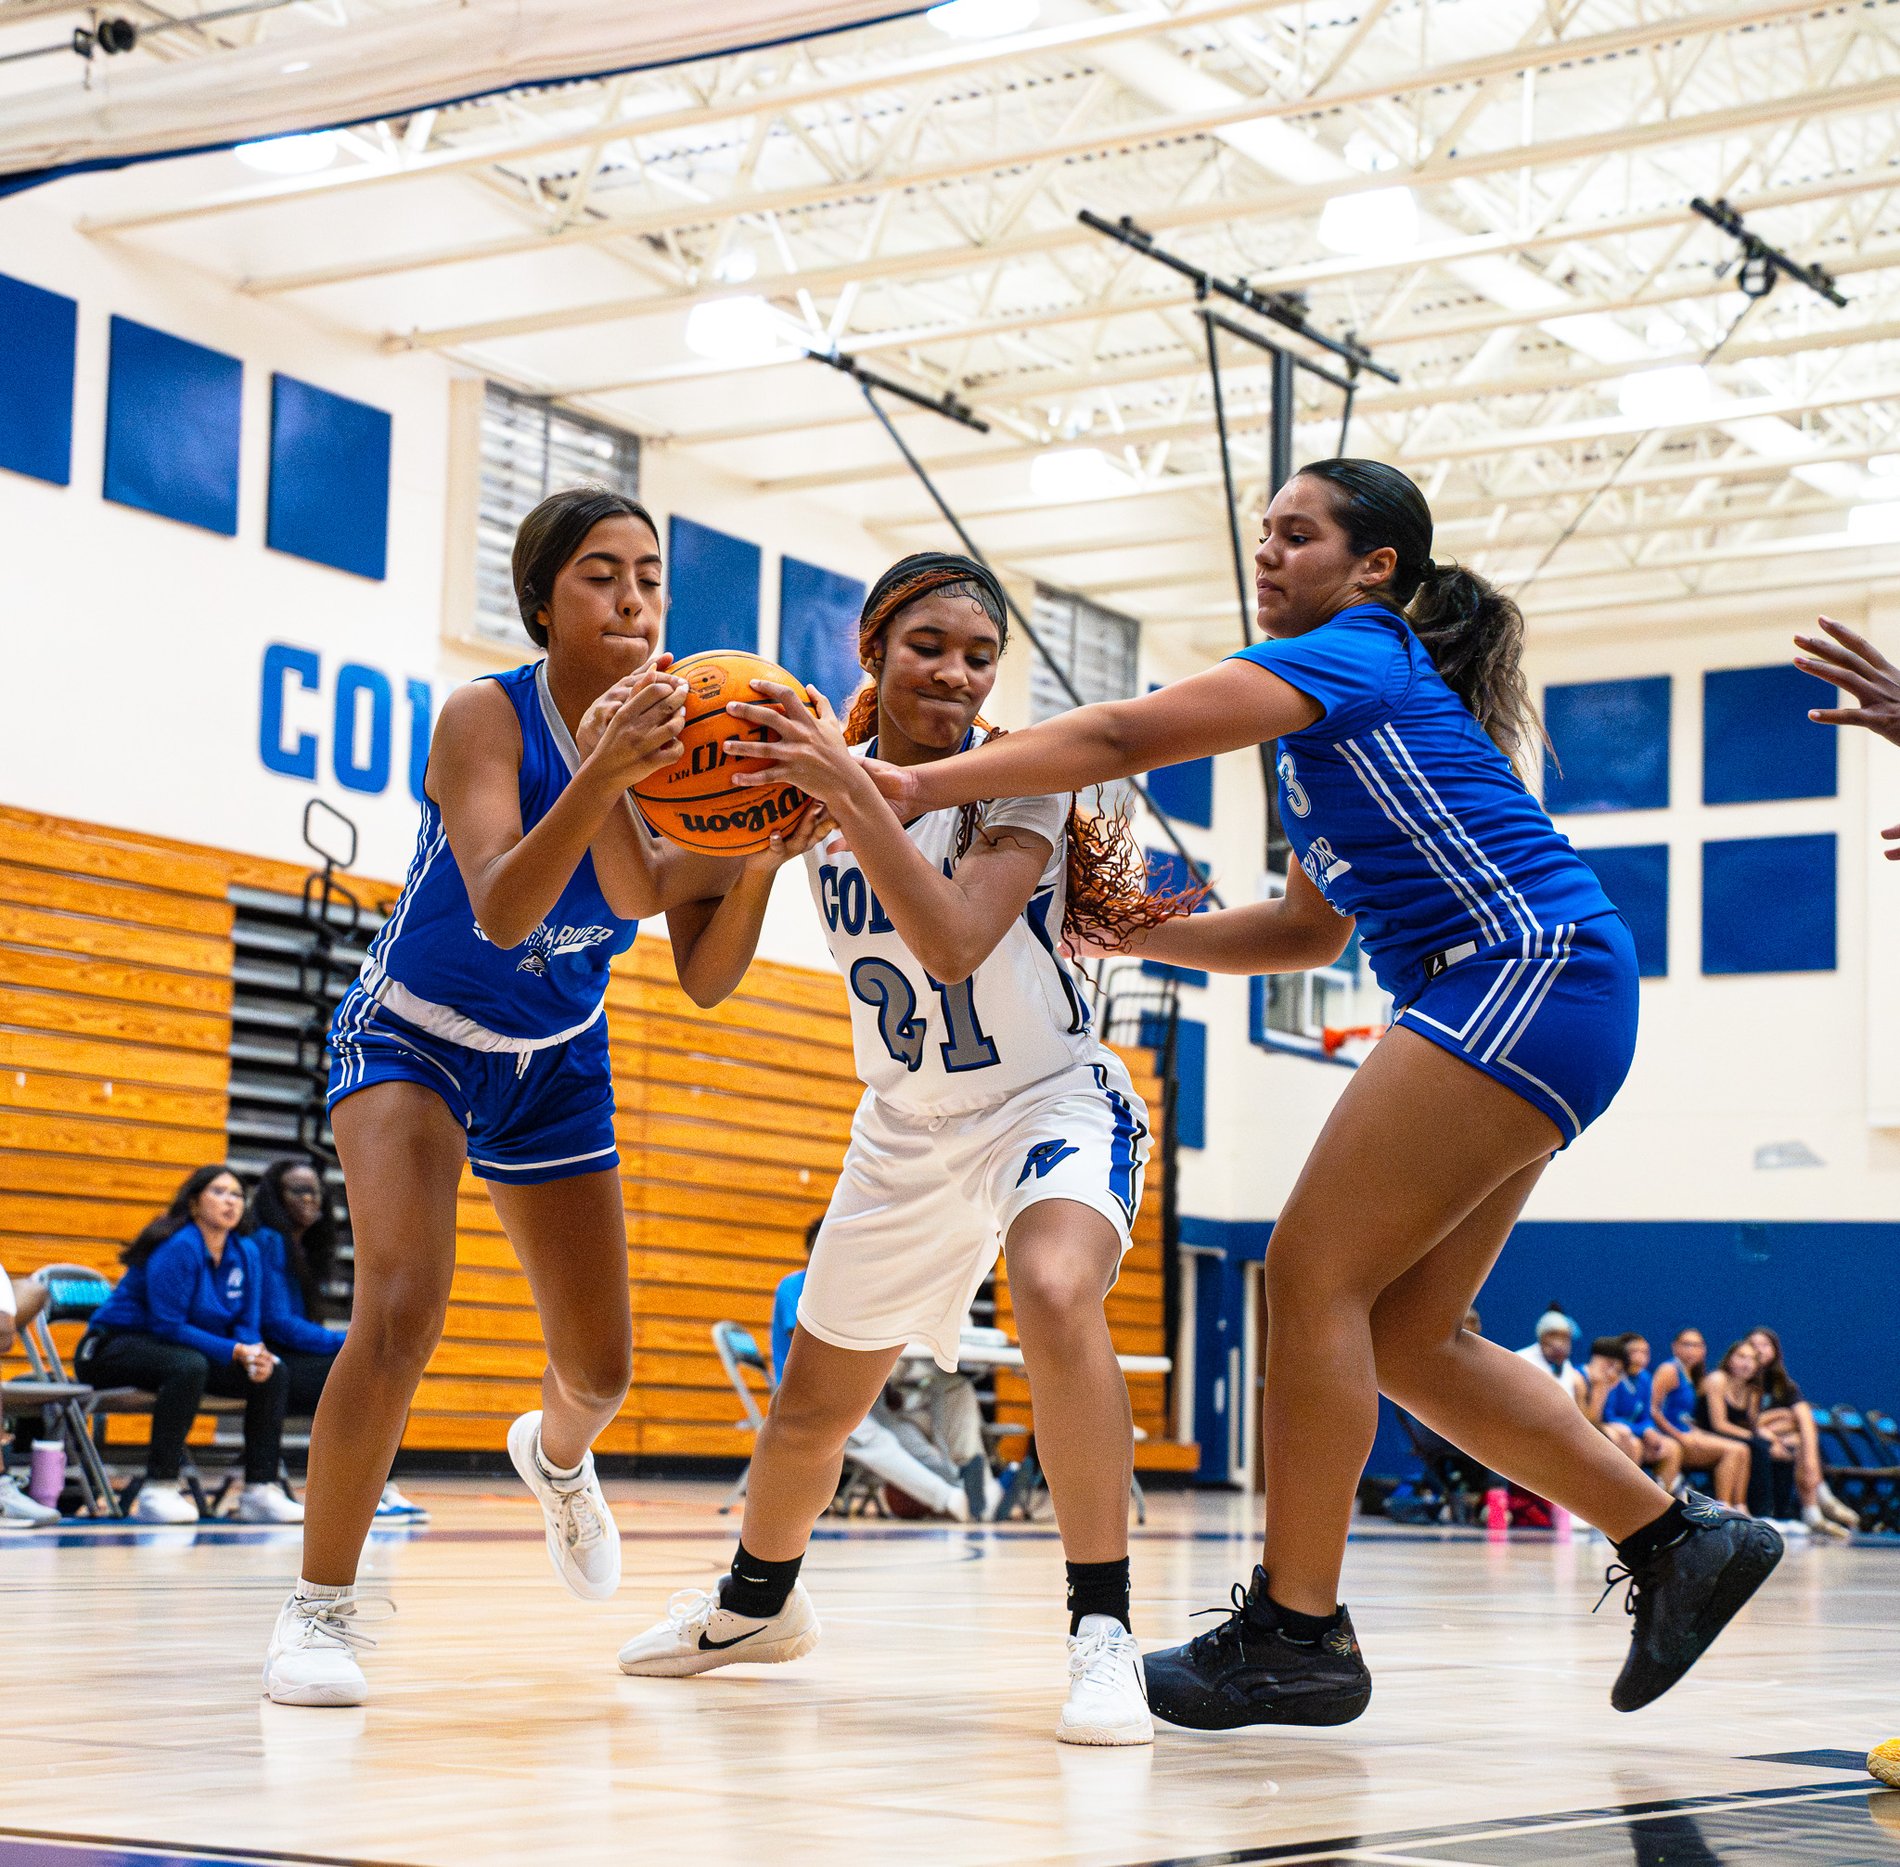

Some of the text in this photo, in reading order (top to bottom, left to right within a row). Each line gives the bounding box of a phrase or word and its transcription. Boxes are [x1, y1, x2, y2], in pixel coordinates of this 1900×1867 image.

[667, 769, 690, 784] NXT
[1277, 752, 1312, 819] 3
[554, 925, 615, 945] RIVER
[850, 956, 1001, 1073] 21
